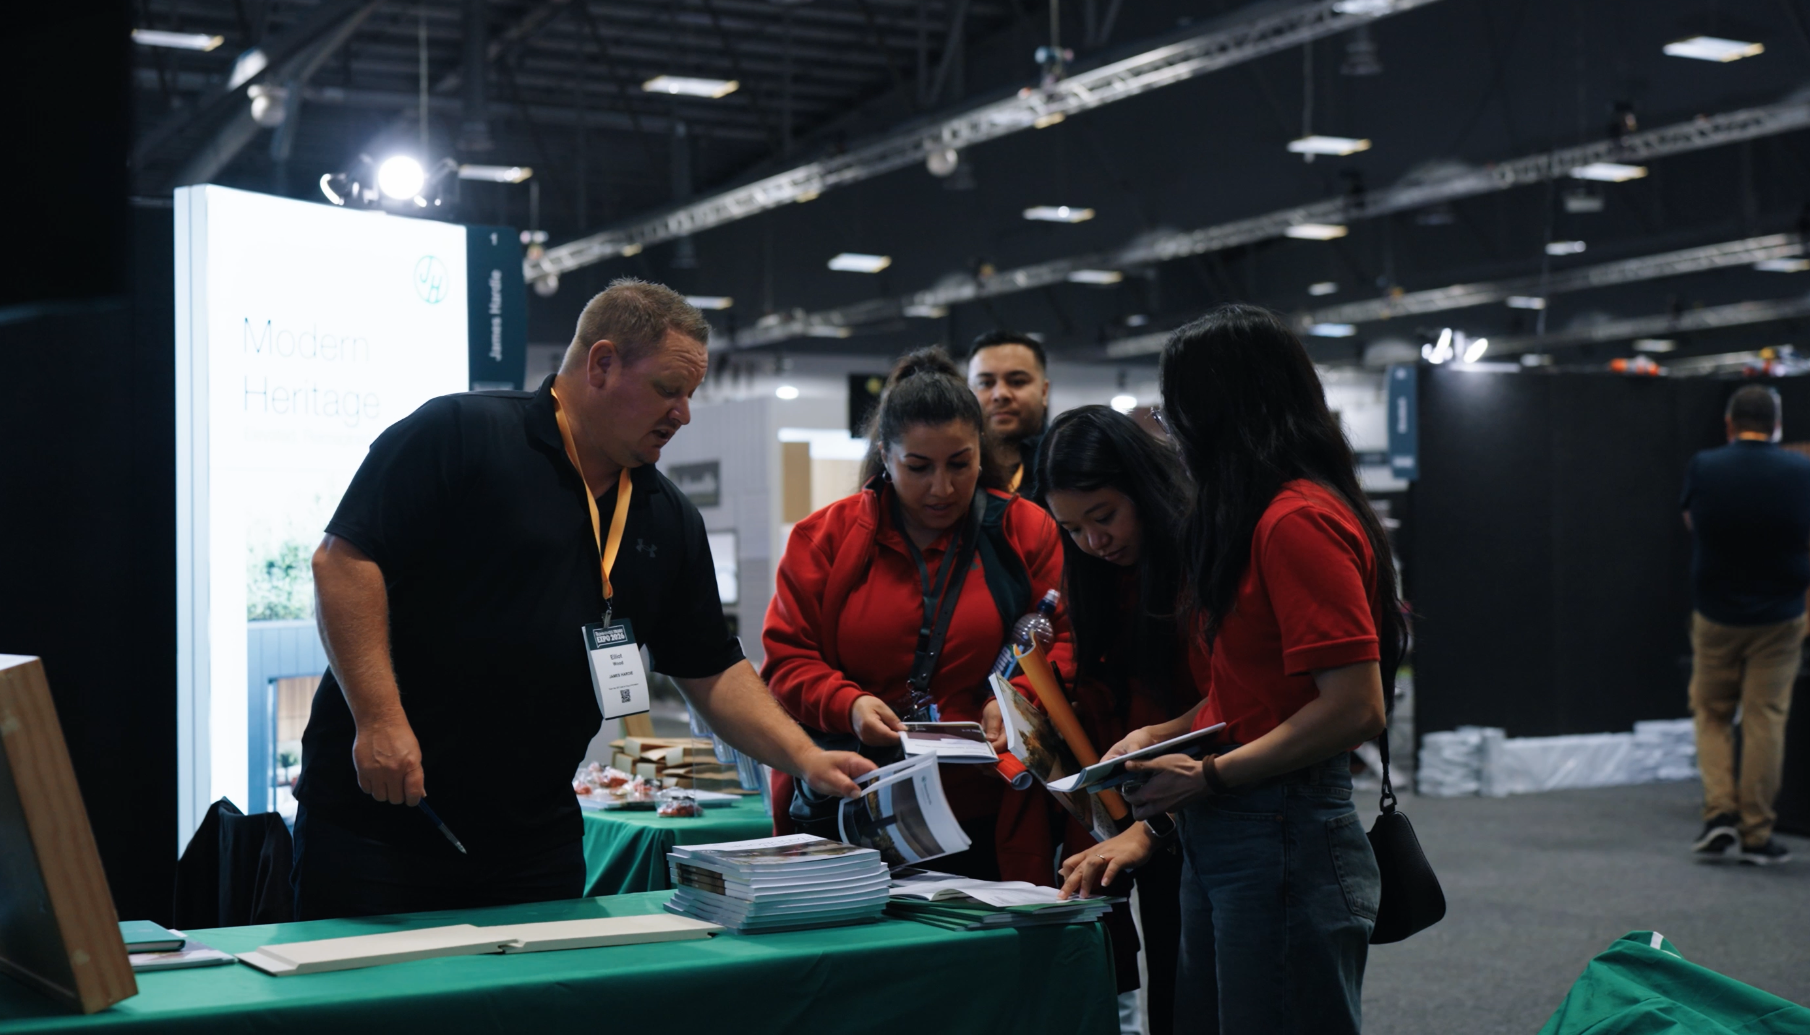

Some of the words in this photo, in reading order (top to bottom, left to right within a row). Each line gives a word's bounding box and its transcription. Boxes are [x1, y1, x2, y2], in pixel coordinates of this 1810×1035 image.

[489, 269, 502, 314] Hardie
[243, 316, 370, 364] Modern
[489, 316, 502, 361] James
[243, 374, 381, 428] Heritage
[597, 634, 610, 643] EXPO
